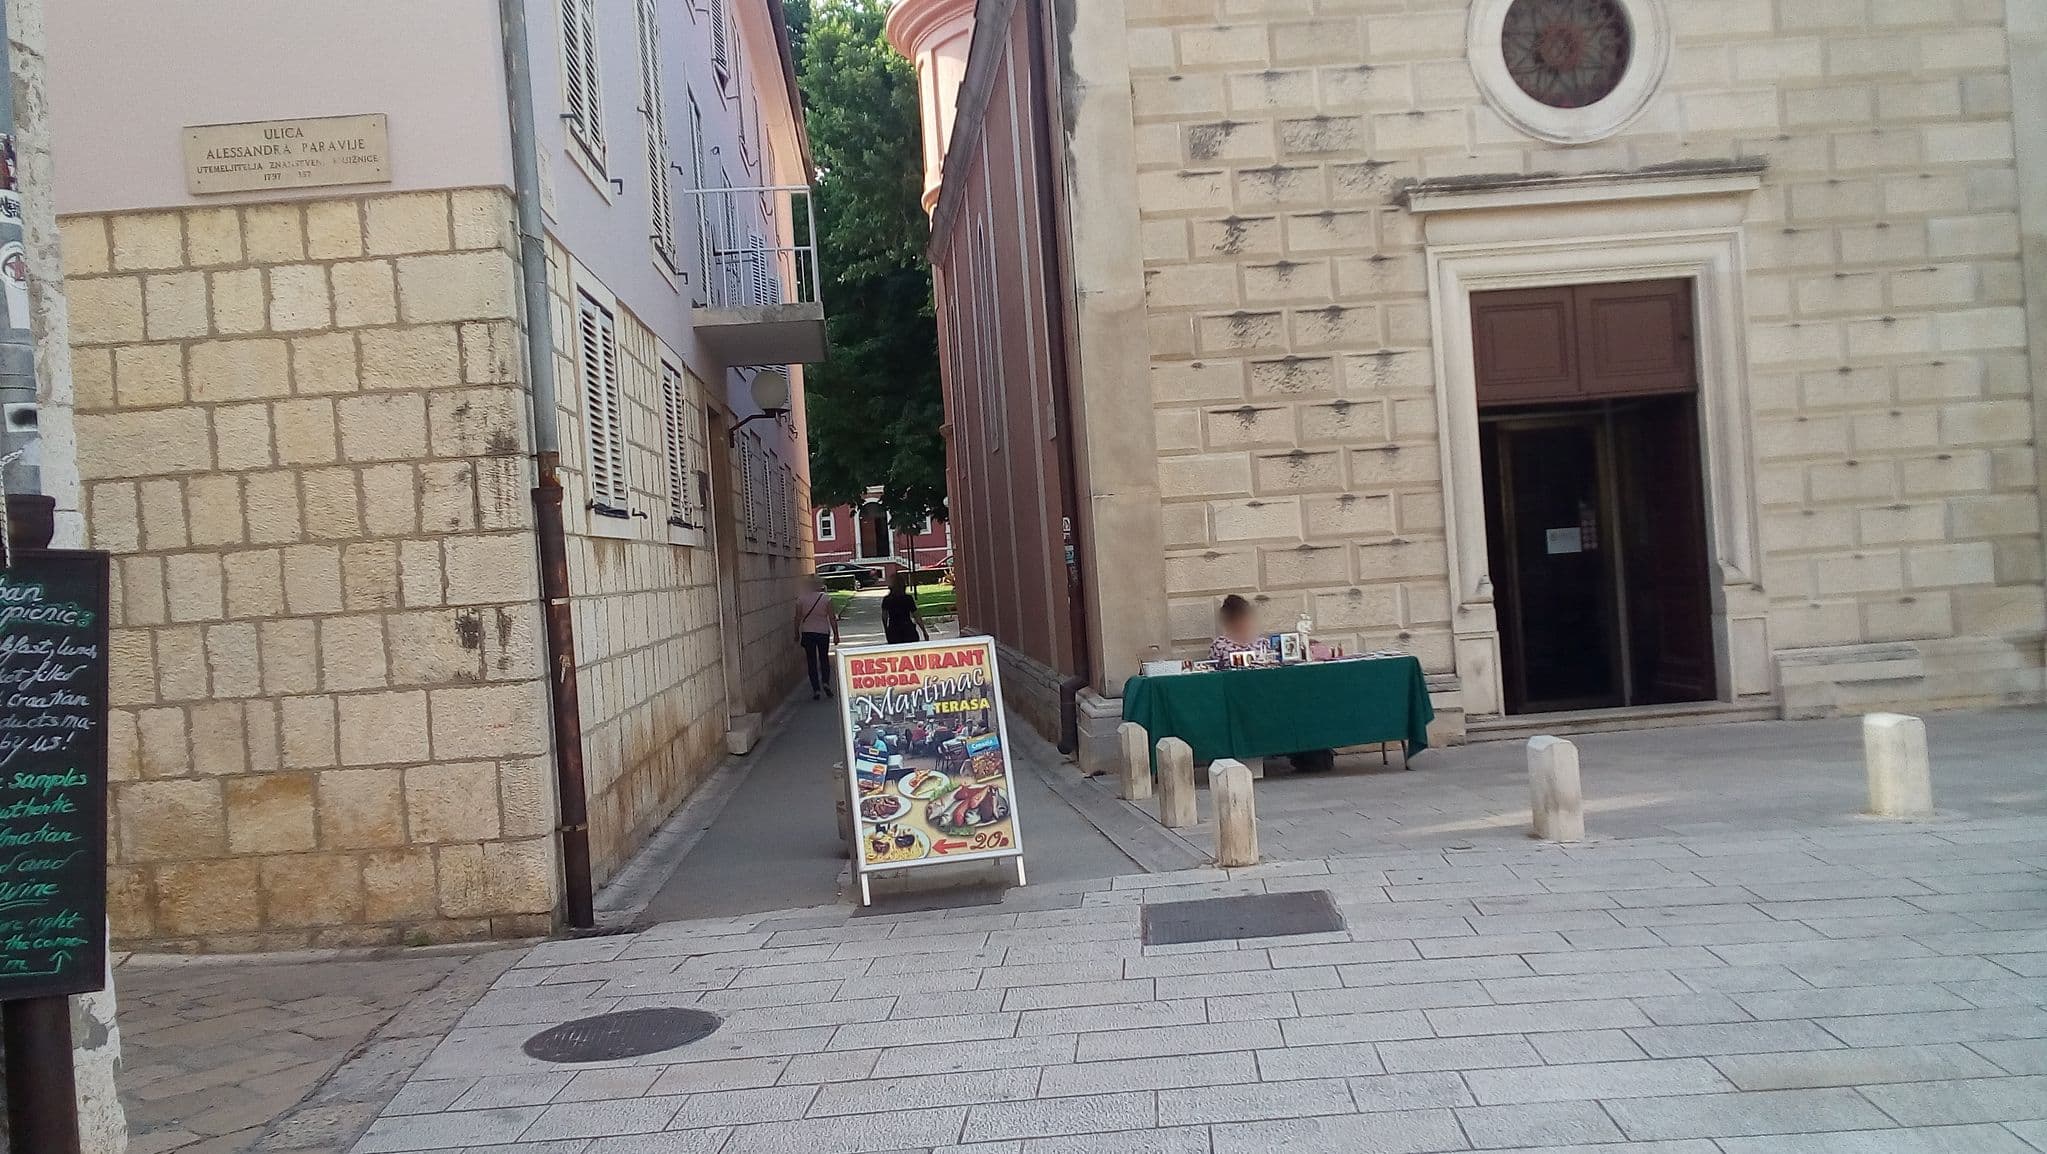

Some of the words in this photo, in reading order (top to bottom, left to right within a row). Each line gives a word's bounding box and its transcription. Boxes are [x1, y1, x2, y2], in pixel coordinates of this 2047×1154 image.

[263, 127, 304, 140] ULICA
[206, 144, 292, 160] ALESSANDRA
[302, 138, 366, 153] PARAVIJE
[850, 650, 984, 676] RESTAURANT
[853, 673, 921, 690] KONOBA
[856, 667, 985, 724] Martinac
[934, 697, 990, 714] TERASA
[7, 767, 88, 797] samples
[5, 934, 30, 951] the
